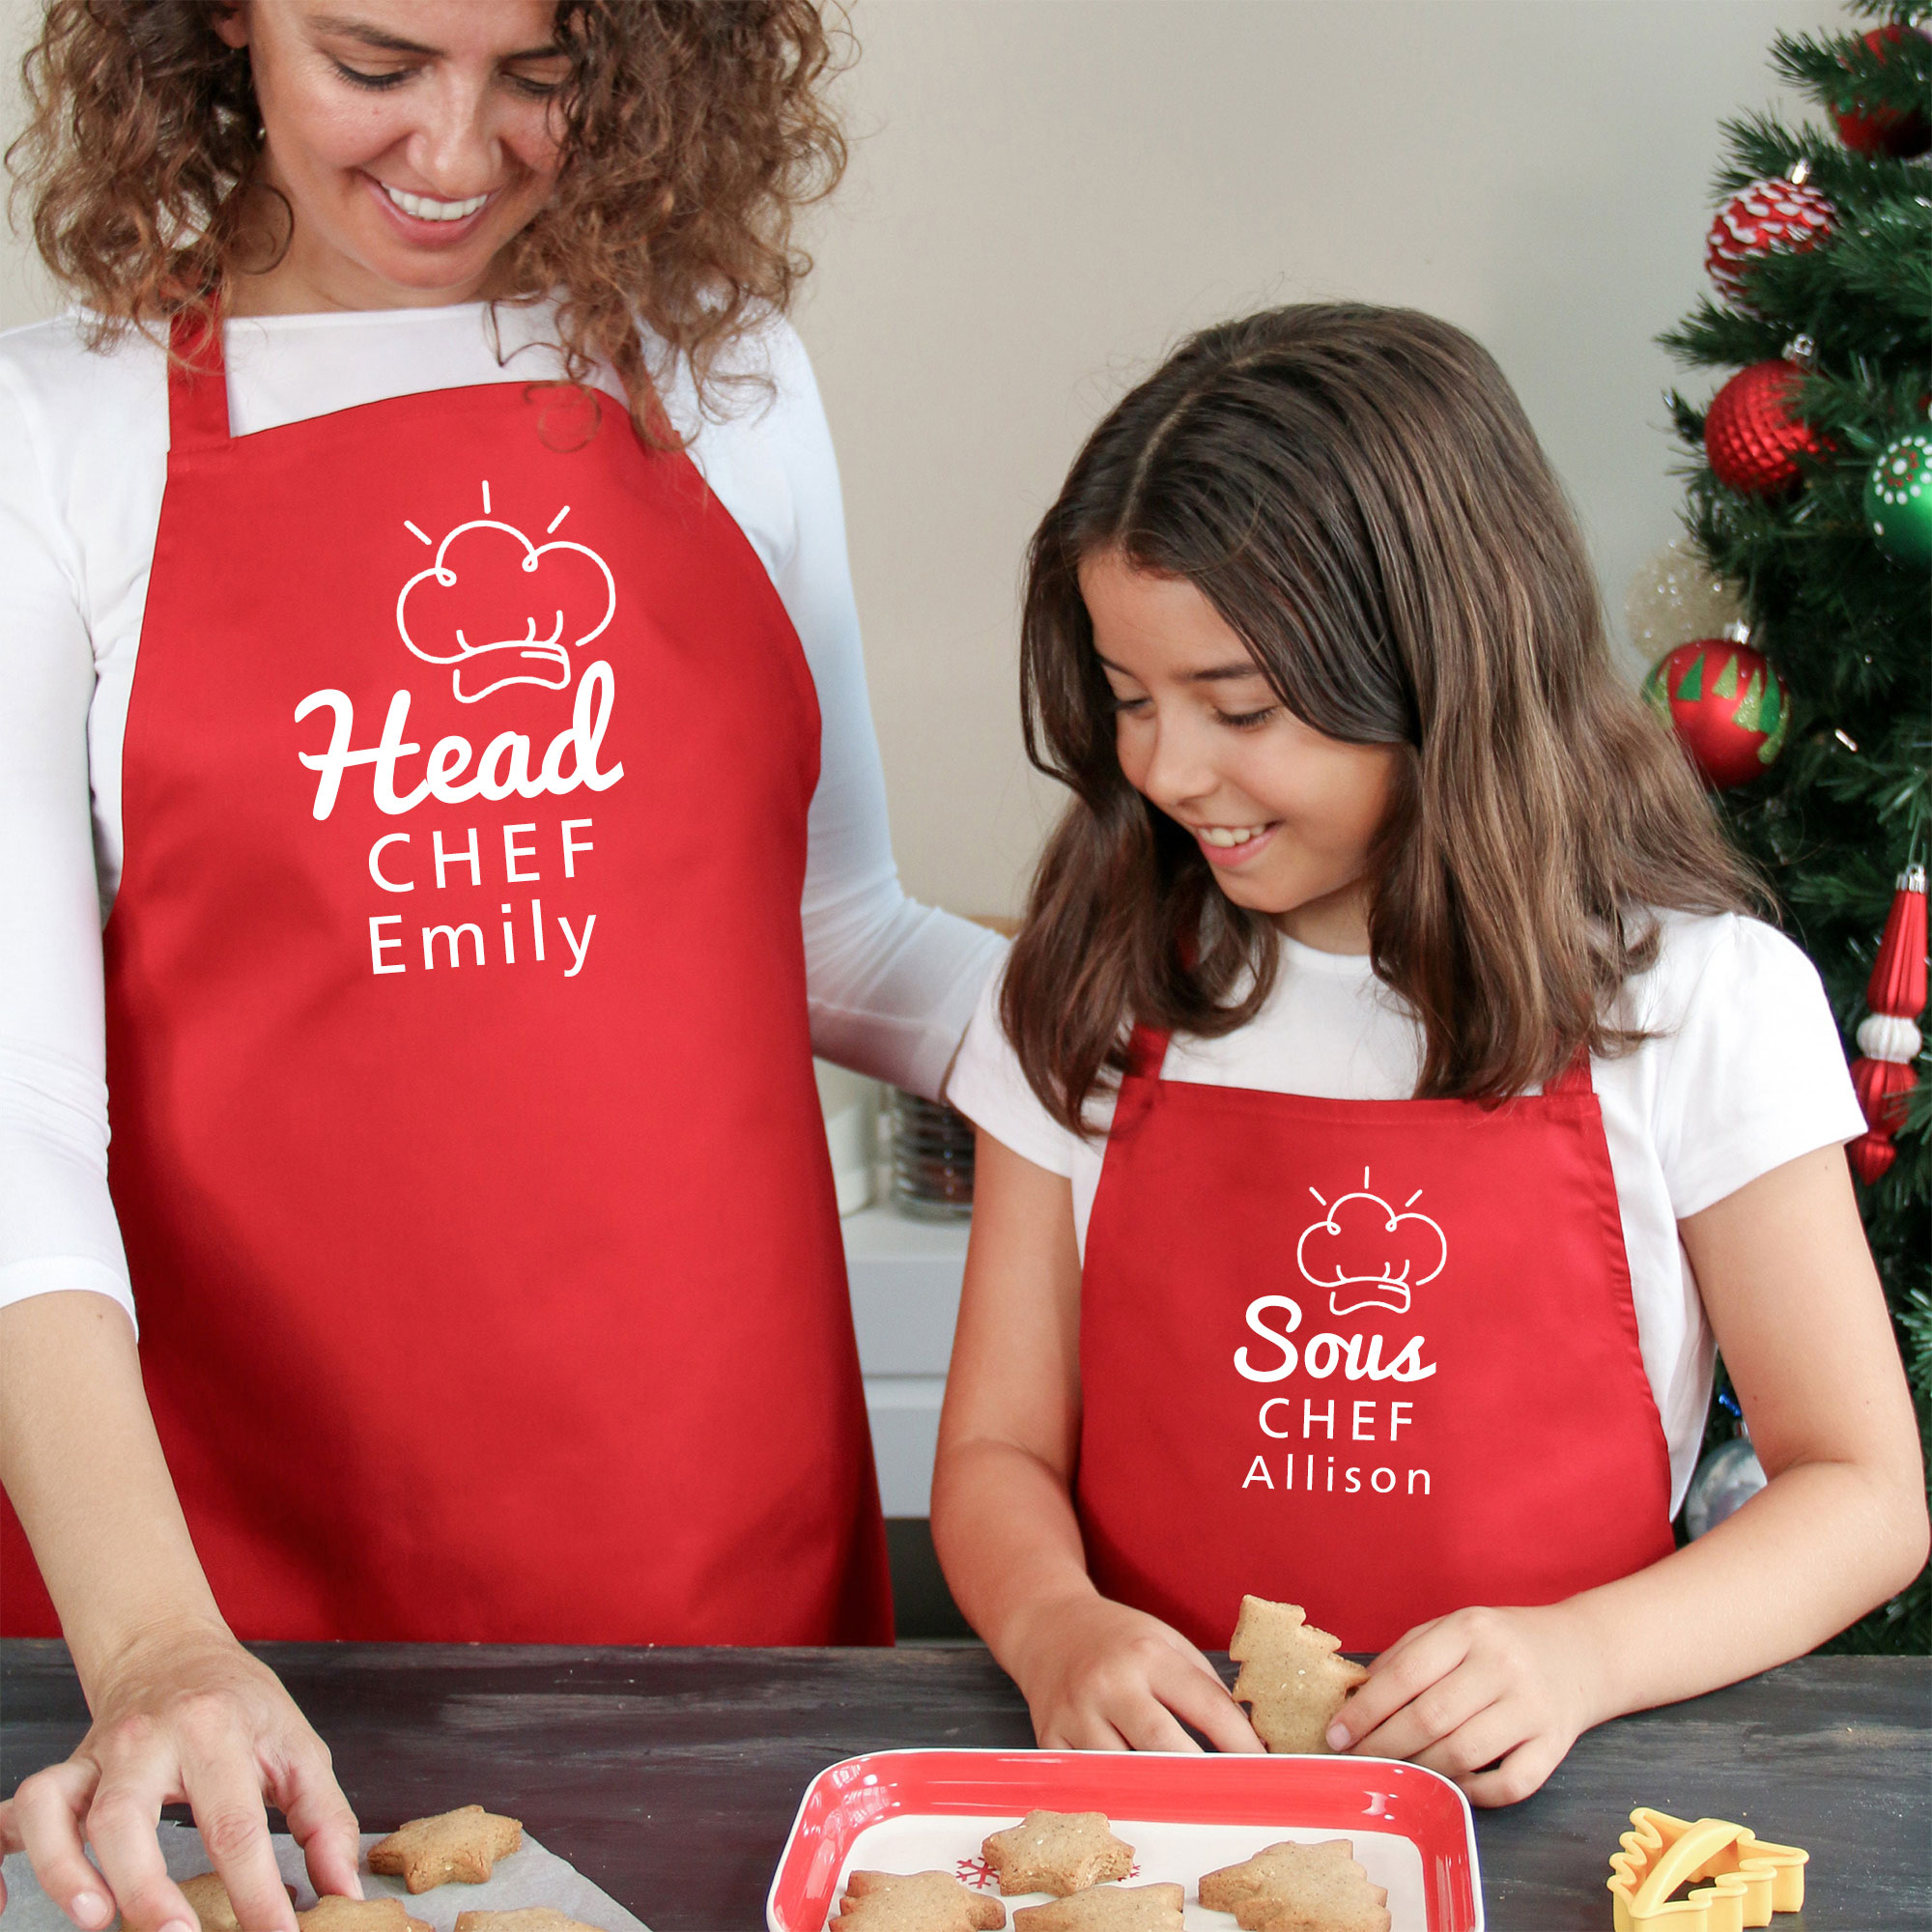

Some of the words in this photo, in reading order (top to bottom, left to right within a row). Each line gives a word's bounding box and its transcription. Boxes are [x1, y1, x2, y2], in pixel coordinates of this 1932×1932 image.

[294, 660, 625, 821] Head
[368, 817, 594, 893] CHEF
[368, 898, 597, 978] Emily
[1233, 1294, 1437, 1383] Sous
[1259, 1397, 1414, 1441] CHEF
[1241, 1453, 1432, 1495] Allison
